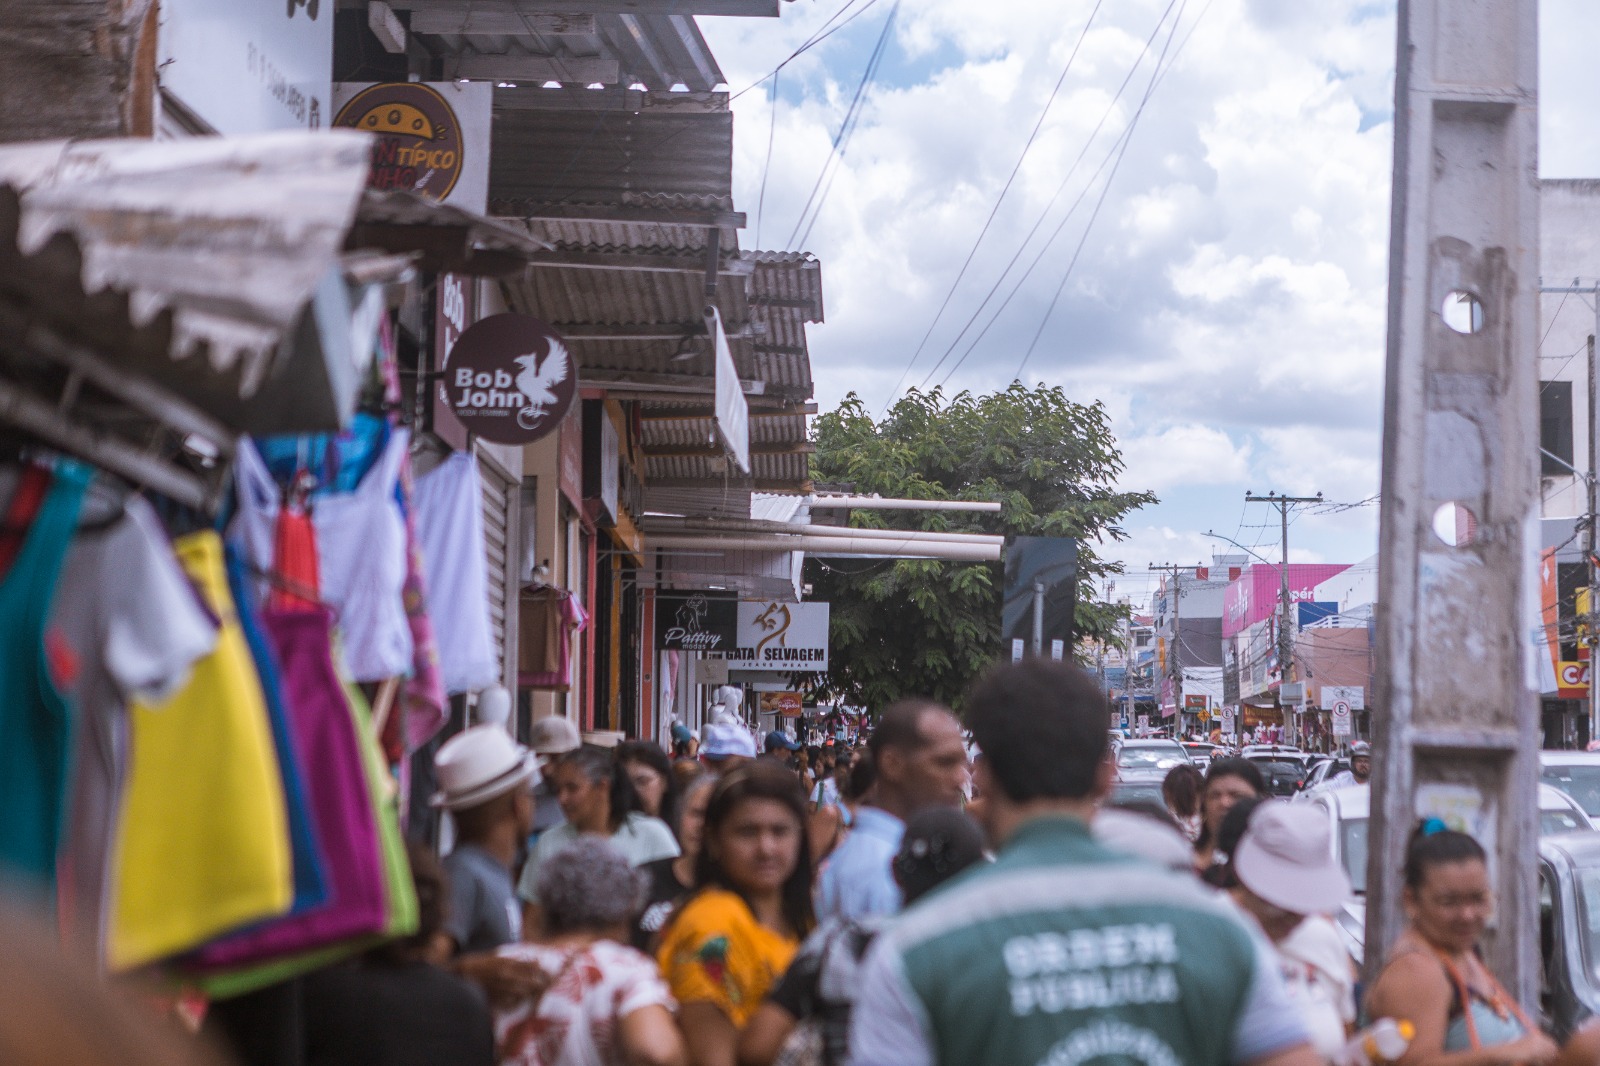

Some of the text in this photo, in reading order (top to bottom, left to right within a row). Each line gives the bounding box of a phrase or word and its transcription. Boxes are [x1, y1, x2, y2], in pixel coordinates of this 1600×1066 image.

[397, 141, 457, 170] TÍPICO
[455, 367, 513, 388] Bob
[455, 387, 525, 408] John
[664, 627, 722, 649] Pattivy
[726, 647, 824, 661] GATA SELVAGEM
[1337, 704, 1345, 714] E
